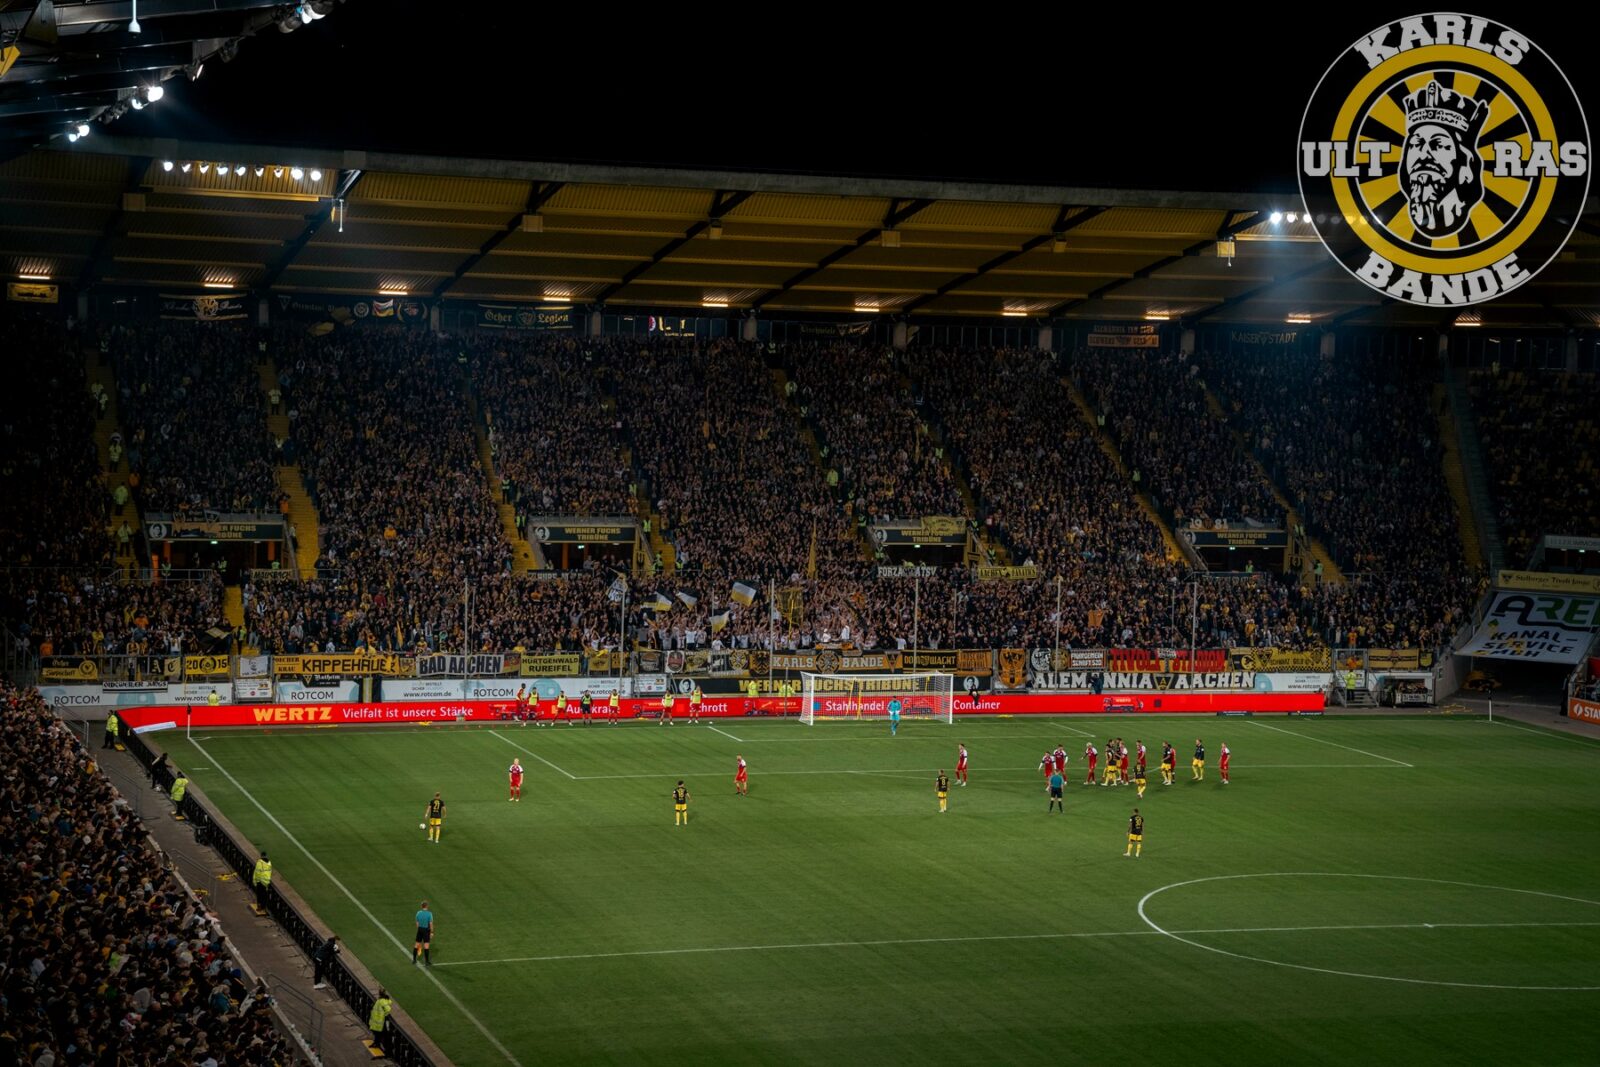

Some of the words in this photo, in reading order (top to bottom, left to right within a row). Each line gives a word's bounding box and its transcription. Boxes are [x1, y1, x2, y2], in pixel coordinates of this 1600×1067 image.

[878, 566, 902, 577] FORZA
[915, 565, 937, 577] ATSV
[186, 660, 198, 669] 20
[217, 659, 227, 668] 15
[419, 656, 446, 674] BAD
[448, 655, 501, 674] AACHEN
[772, 657, 813, 668] KARLS
[842, 656, 884, 667] BANDE
[528, 664, 572, 672] RUREIFEL
[1034, 672, 1153, 689] ALEMNNIA
[1175, 672, 1256, 689] AACHEN
[291, 691, 334, 700] ROTCOM
[473, 688, 514, 697] ROTCOM
[54, 695, 100, 704] ROTCOM
[953, 699, 1001, 710] Container
[825, 700, 884, 711] Stahlhandel
[253, 706, 332, 721] WERTZ
[342, 707, 383, 719] Vielfalt
[386, 707, 399, 718] ist
[402, 708, 436, 717] unsere
[440, 706, 474, 717] Stärke
[1584, 706, 1600, 720] STA
